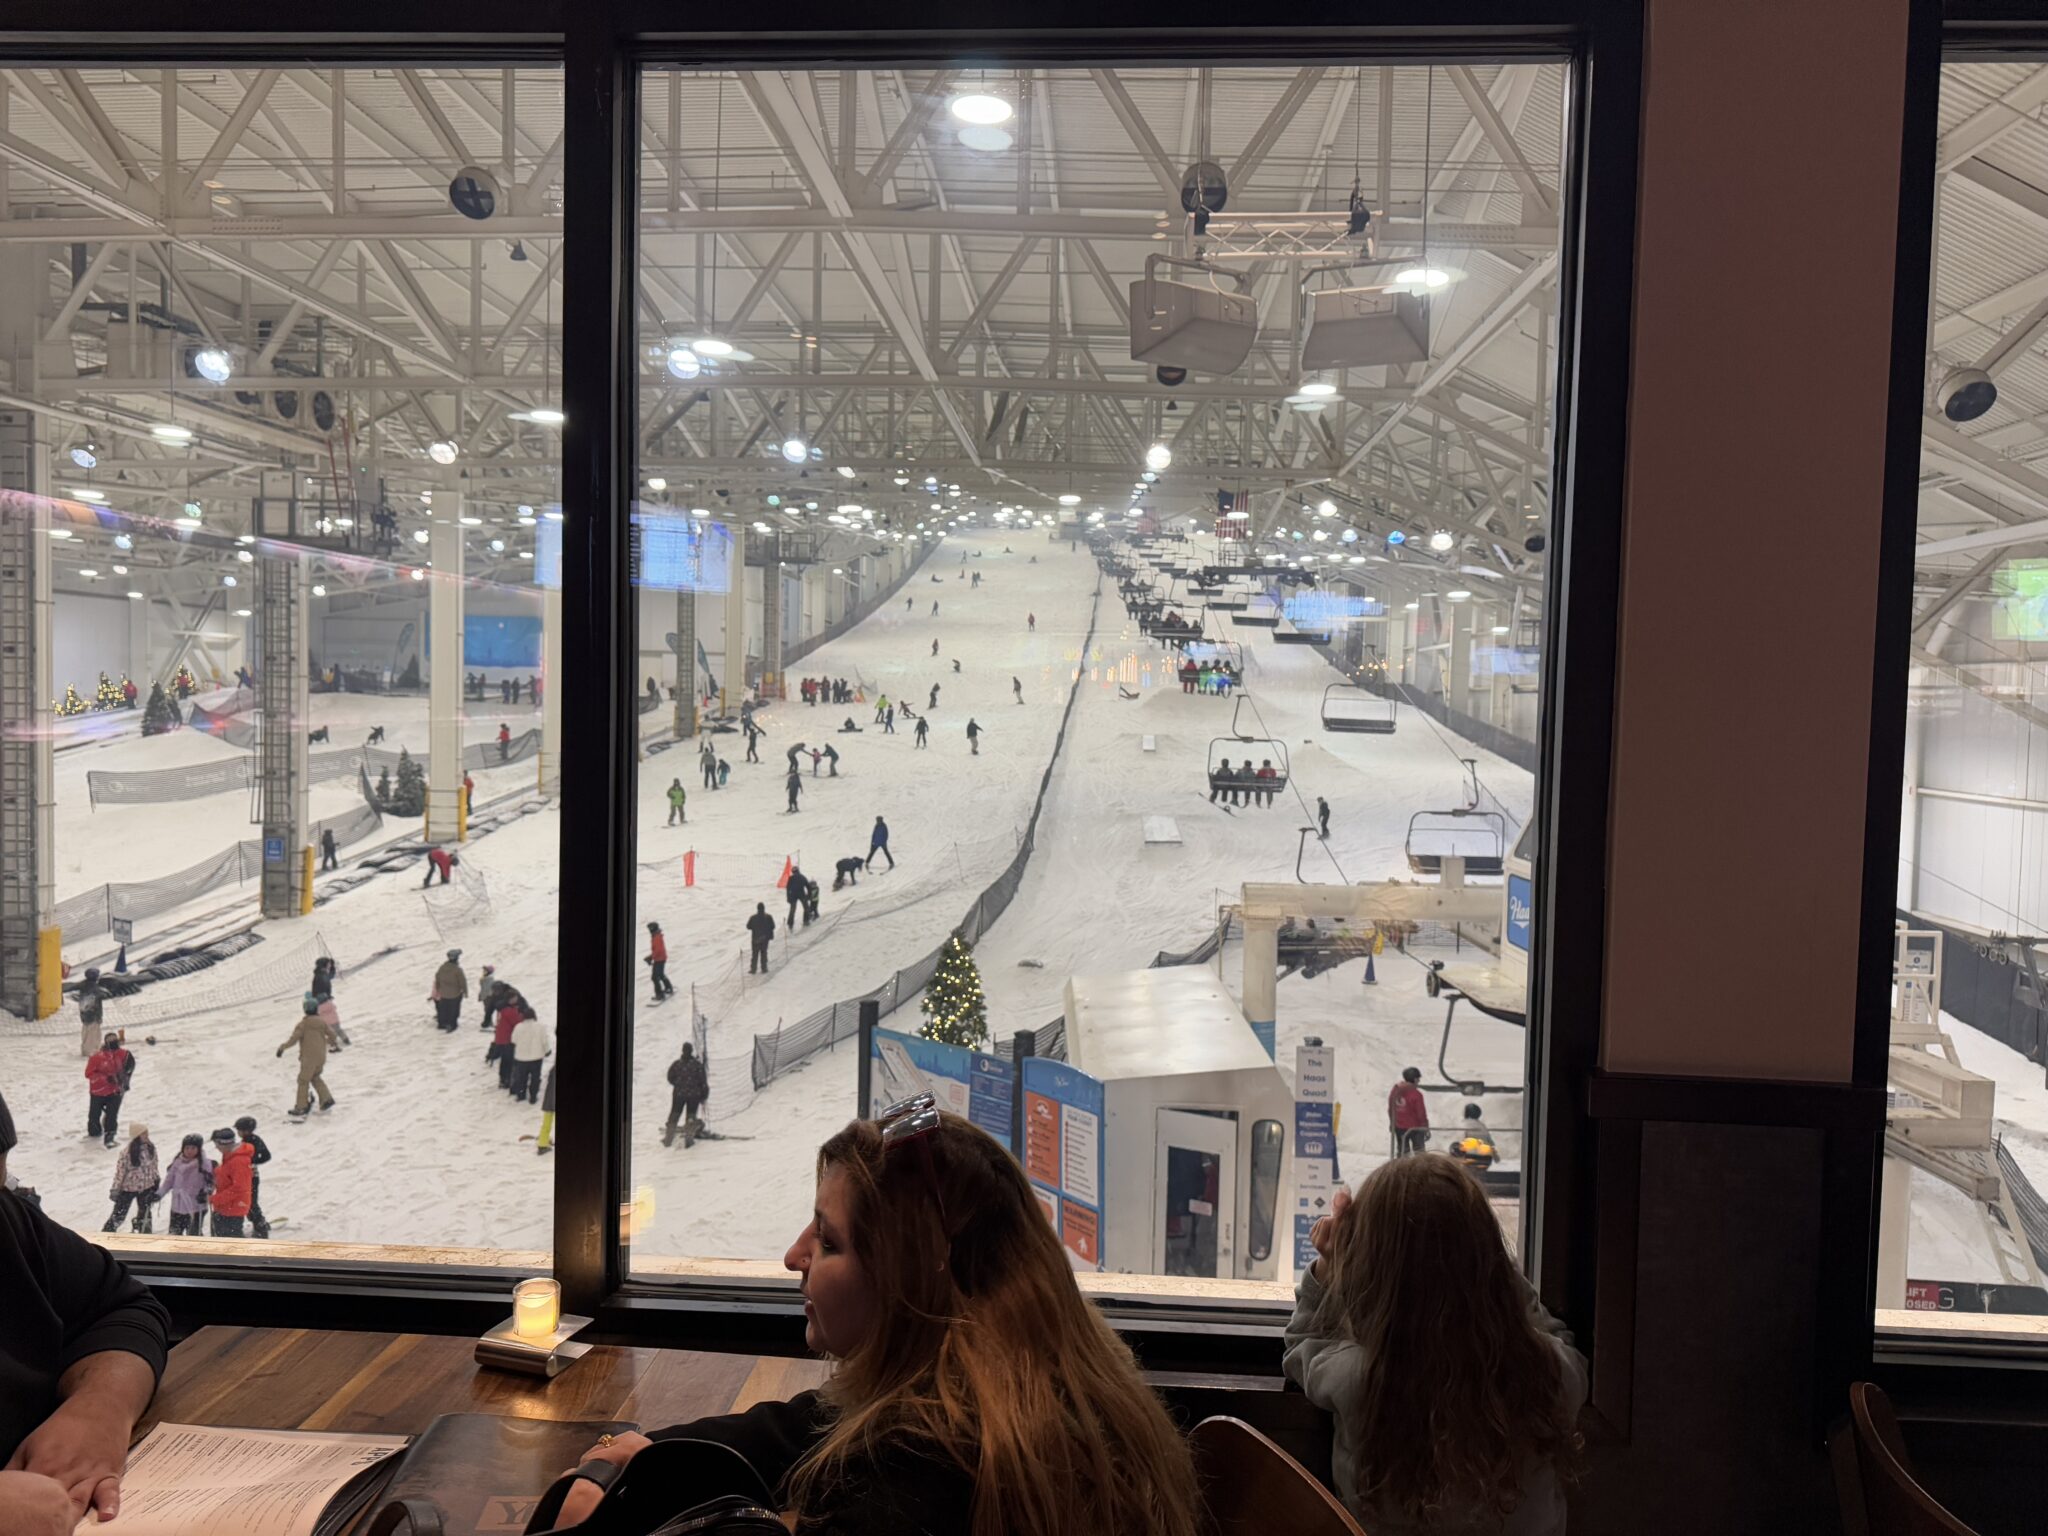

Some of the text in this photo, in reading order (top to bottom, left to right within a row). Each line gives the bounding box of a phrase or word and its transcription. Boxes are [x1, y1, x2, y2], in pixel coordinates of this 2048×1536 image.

[1510, 896, 1530, 921] Haa
[1308, 1059, 1322, 1067] The
[1303, 1074, 1326, 1082] Haas
[1302, 1089, 1327, 1097] Quad
[1300, 1130, 1328, 1138] Capacity
[1906, 1287, 1927, 1297] IFT
[1906, 1299, 1936, 1310] OSED
